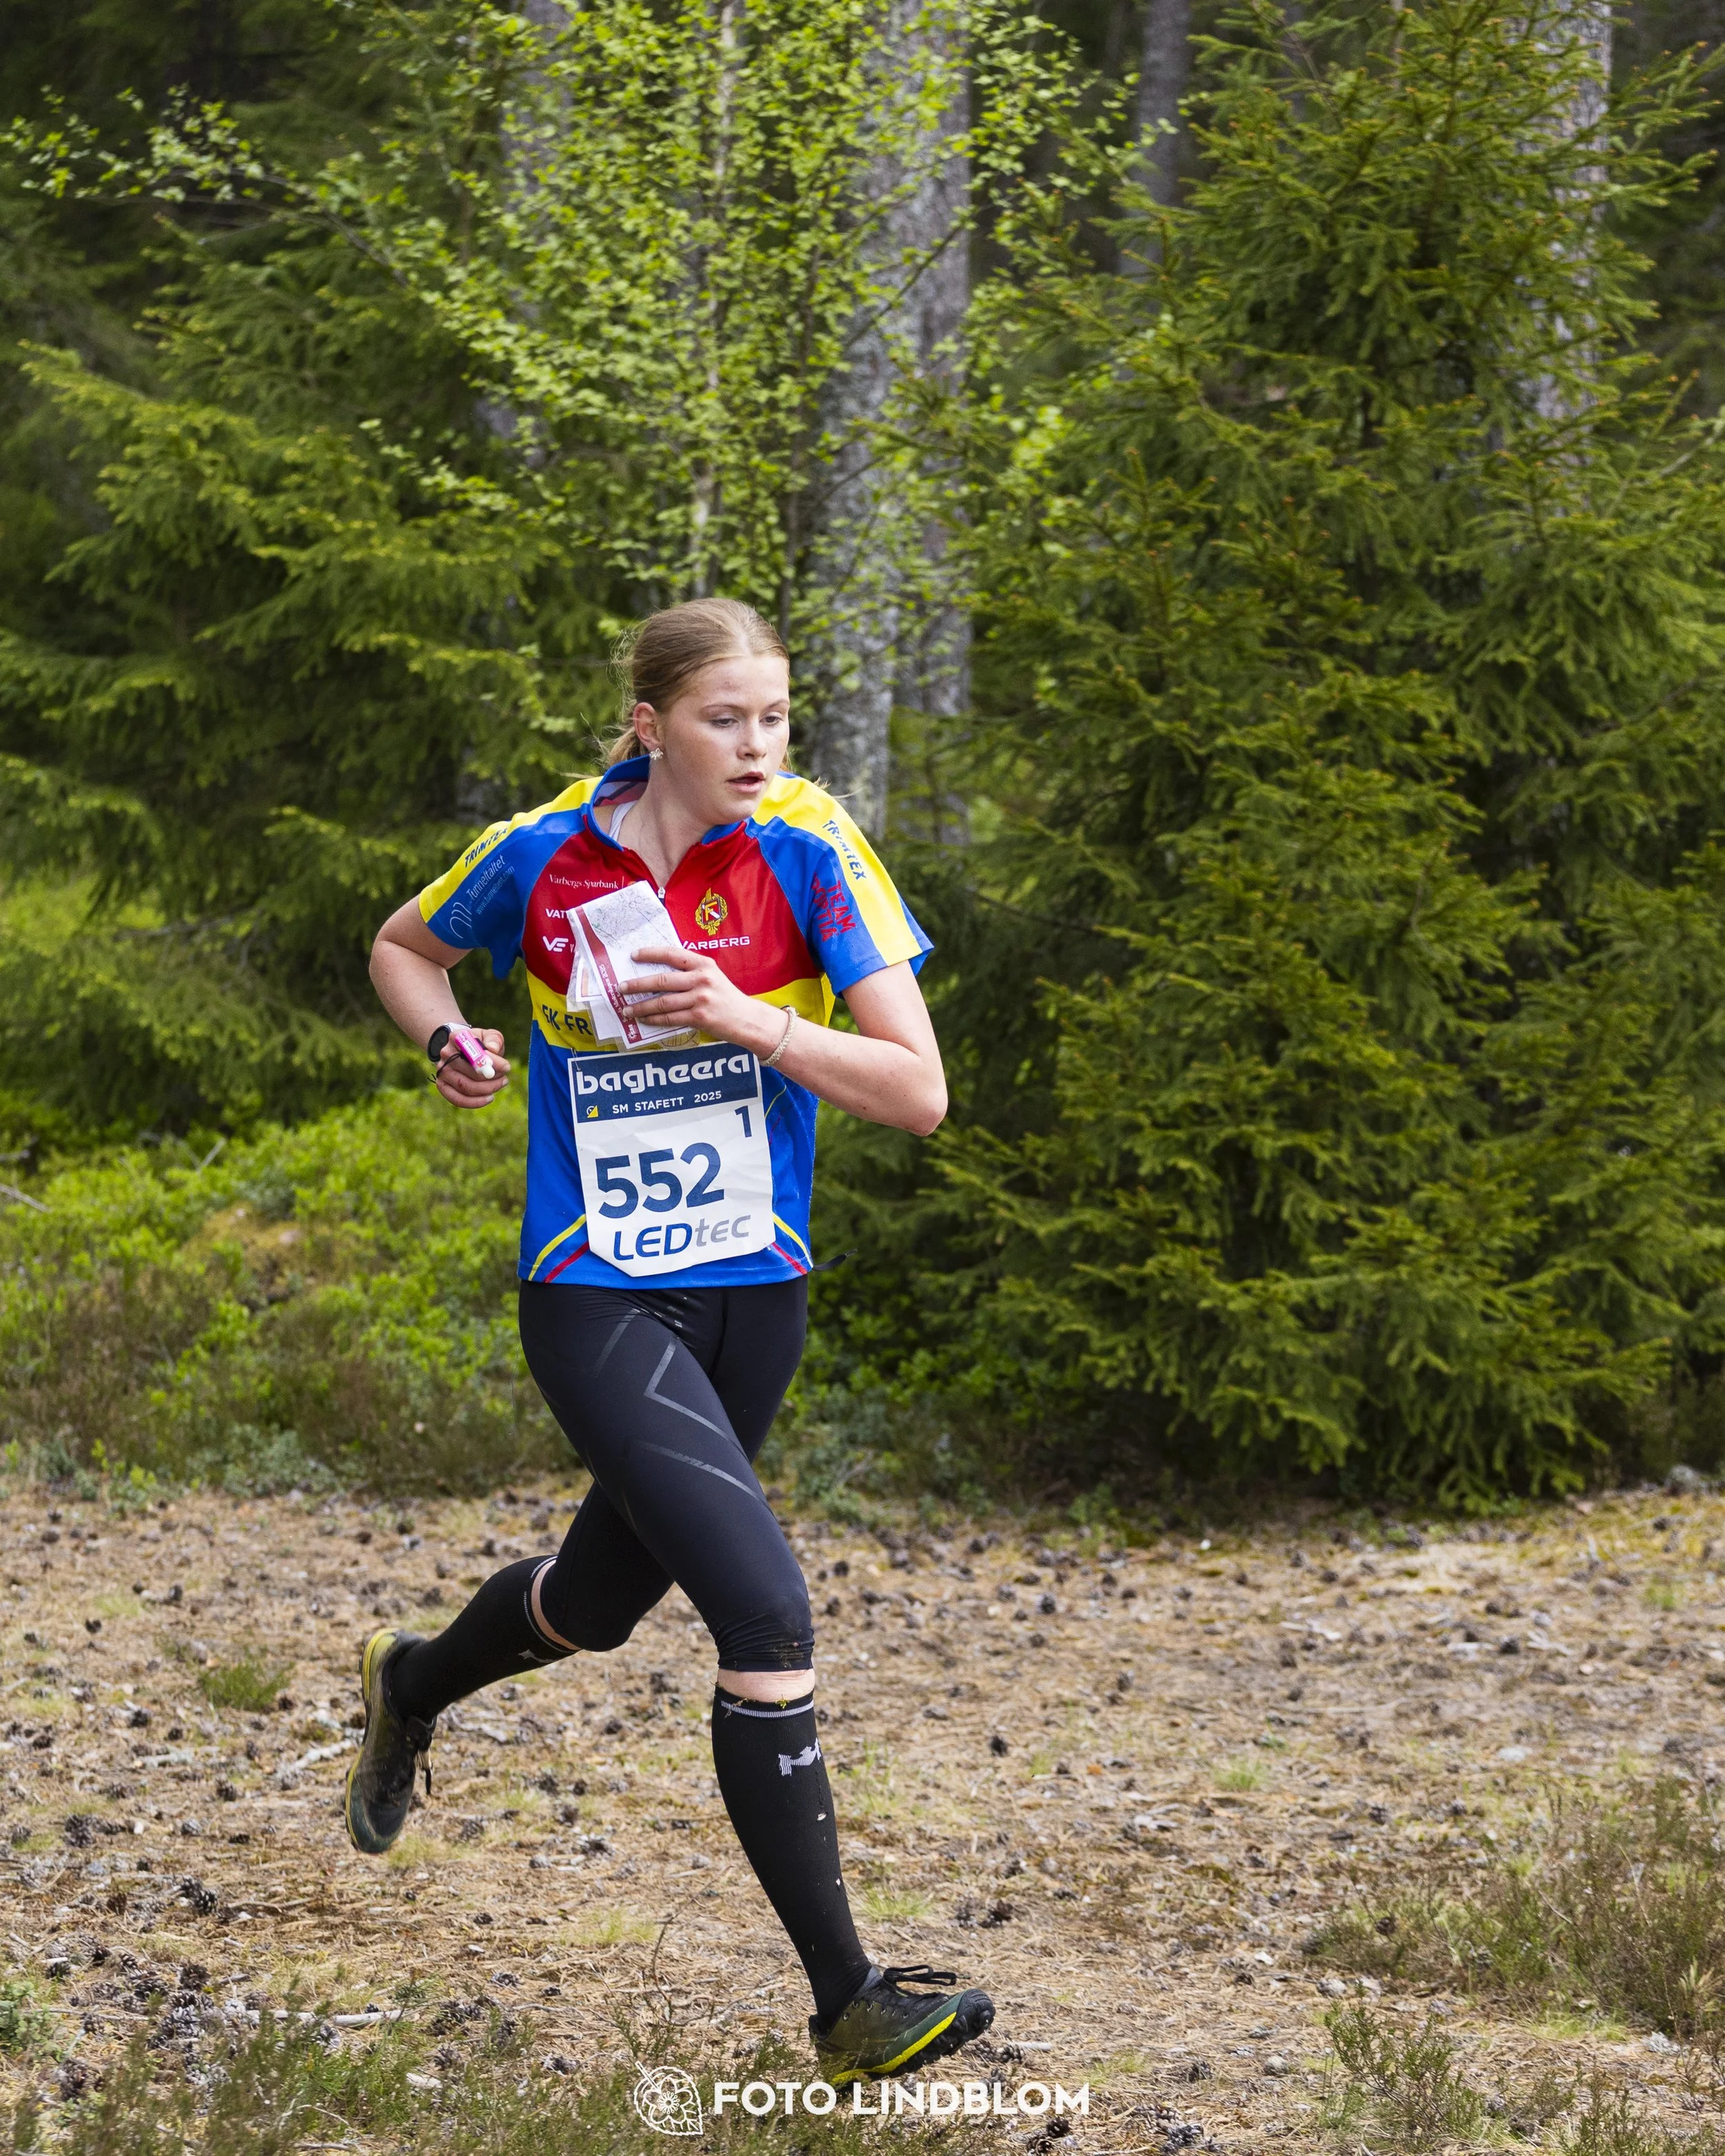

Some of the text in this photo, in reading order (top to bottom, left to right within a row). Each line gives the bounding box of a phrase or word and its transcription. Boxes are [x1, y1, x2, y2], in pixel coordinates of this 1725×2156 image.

[465, 827, 509, 868] TRIMTEX
[466, 854, 506, 901] Tunneltältet
[549, 873, 619, 889] Varbergs Sparbank
[827, 880, 856, 933] TEAM
[576, 1054, 751, 1096] bagheera
[612, 1090, 722, 1114] SM STAFETT 2025
[734, 1105, 752, 1138] 1
[595, 1142, 724, 1219] 552
[613, 1214, 751, 1261] LEDtec
